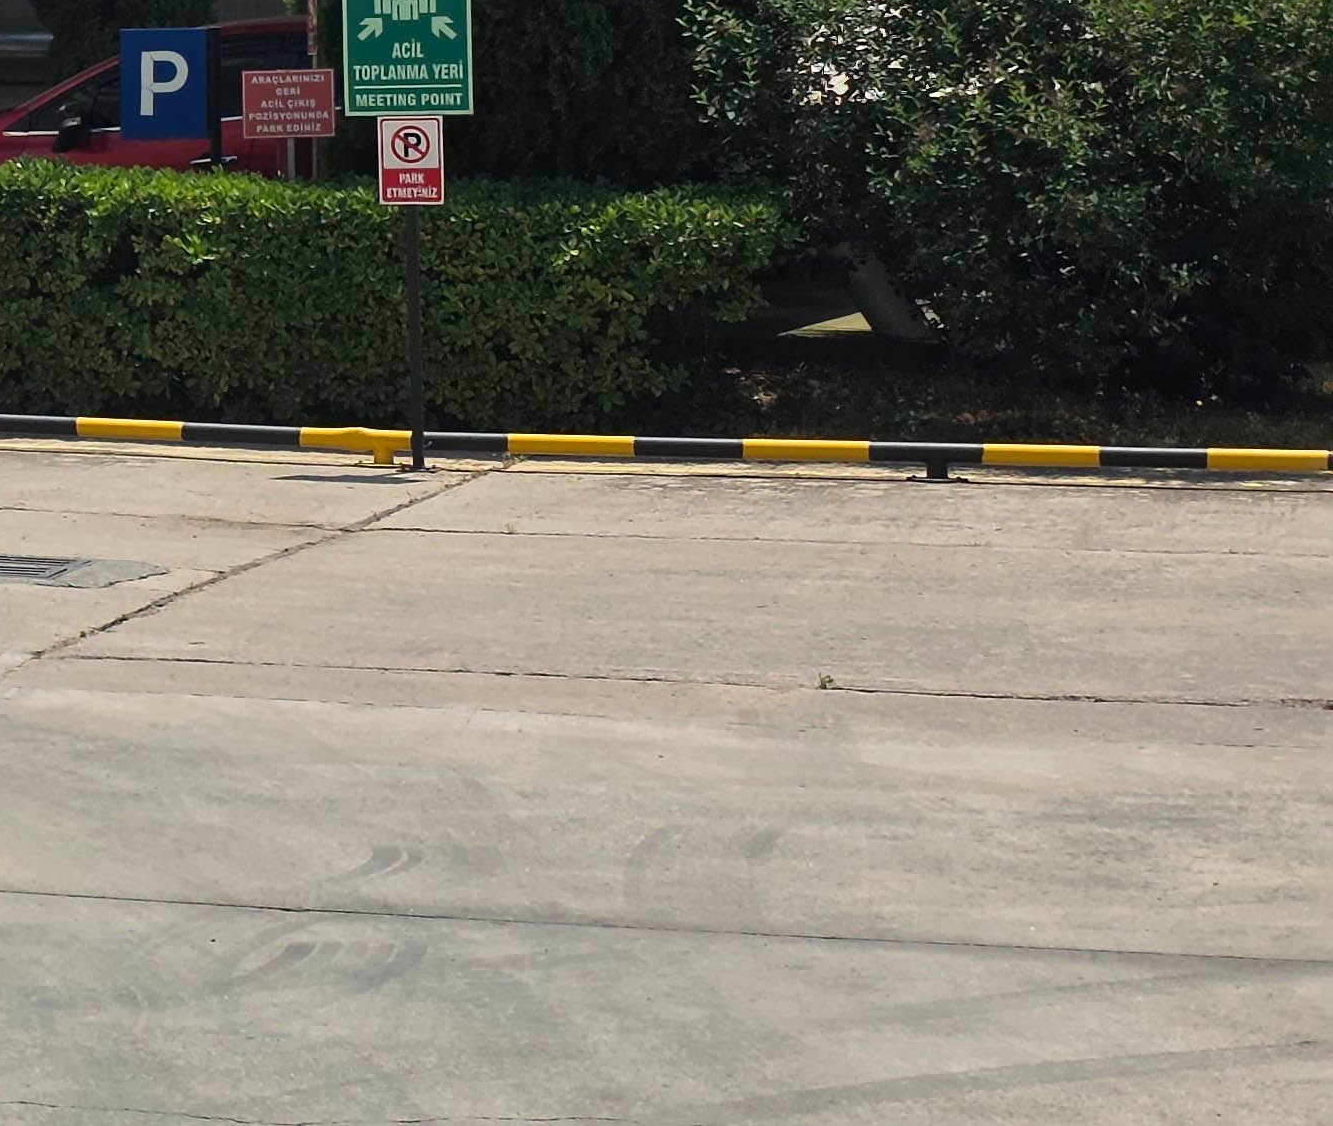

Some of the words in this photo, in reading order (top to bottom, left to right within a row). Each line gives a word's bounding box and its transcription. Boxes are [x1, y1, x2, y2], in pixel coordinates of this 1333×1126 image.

[391, 38, 425, 59] ACİL
[352, 63, 429, 81] TOPLANMA
[432, 59, 464, 80] YERİ
[140, 50, 189, 116] P
[355, 93, 417, 107] MEETING
[420, 92, 463, 106] POINT
[256, 124, 284, 133] PARK
[399, 173, 425, 184] PARK
